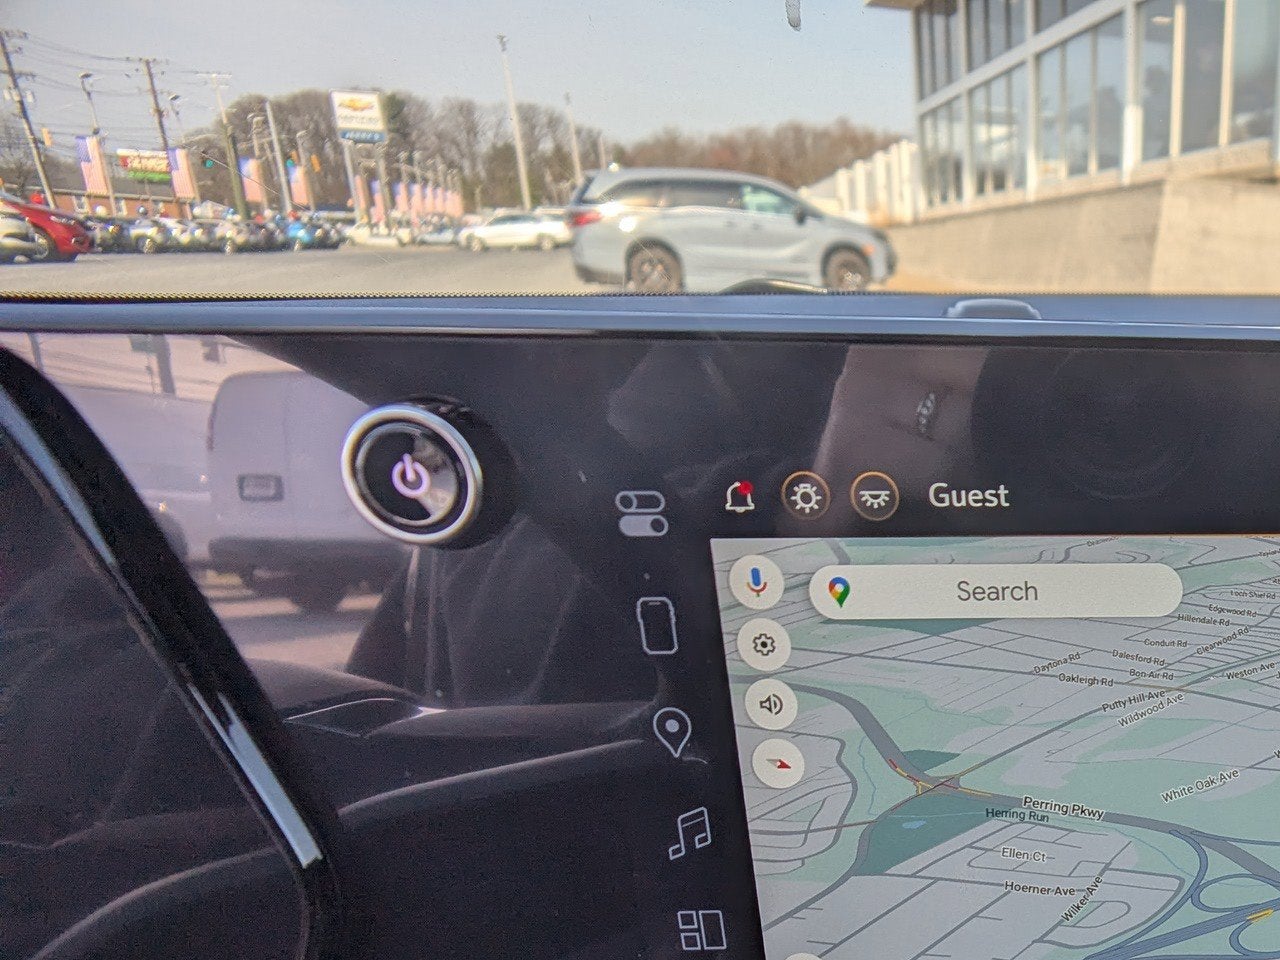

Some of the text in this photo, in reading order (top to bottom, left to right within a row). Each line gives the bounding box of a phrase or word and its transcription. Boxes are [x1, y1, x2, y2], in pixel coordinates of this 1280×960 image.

[928, 482, 1010, 508] Guest
[956, 580, 1039, 602] Search
[1177, 613, 1230, 627] Hillendale Rd
[1208, 604, 1257, 618] Edgewood Rd
[1144, 638, 1188, 648] Conduit Rd
[1196, 626, 1250, 655] Clearwood Rd
[1033, 651, 1081, 675] Daytona Rd
[1112, 649, 1165, 666] Dalesford Rd
[1129, 668, 1174, 681] Bon Air Rd
[1226, 661, 1276, 680] Weston Ave
[1058, 673, 1114, 688] Oakleigh Rd
[1101, 689, 1166, 712] Putty Hill Ave
[1117, 692, 1184, 727] Wildwood Ave
[1161, 768, 1240, 803] White Oak Ave
[985, 807, 1049, 823] Herring Run
[1023, 795, 1104, 821] Perring Pkwy
[1001, 847, 1046, 862] Ellen Ct
[1004, 880, 1076, 896] Hoerner Ave
[1061, 875, 1103, 922] Wilker Ave
